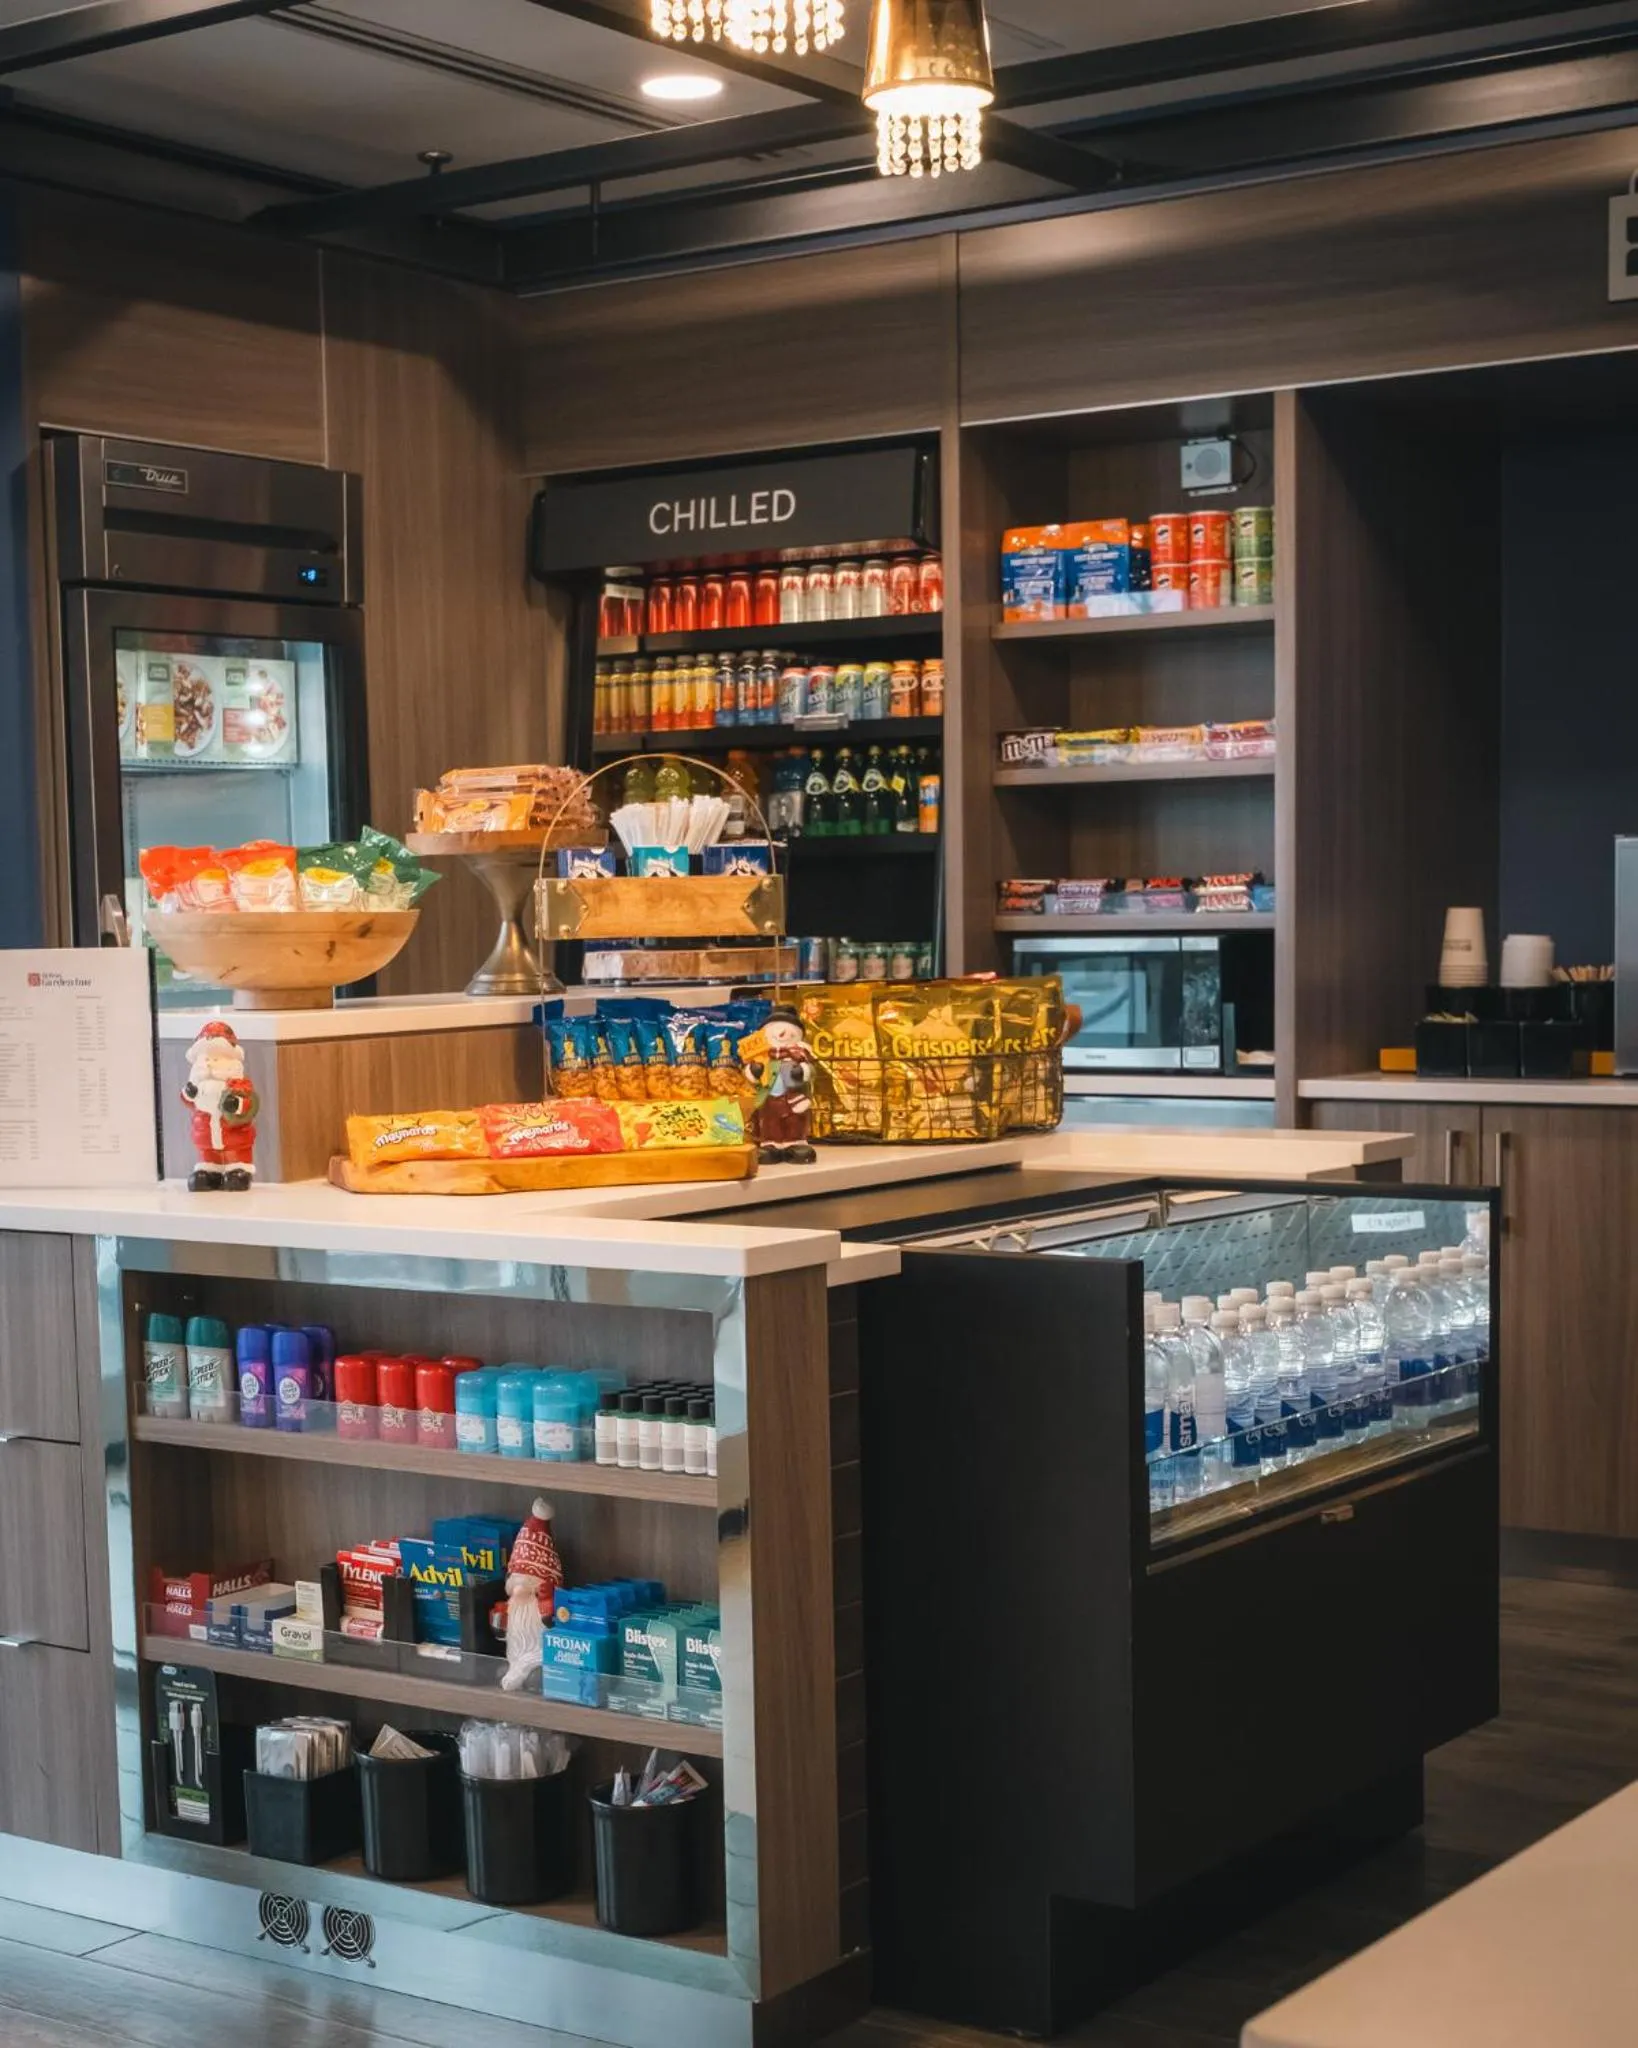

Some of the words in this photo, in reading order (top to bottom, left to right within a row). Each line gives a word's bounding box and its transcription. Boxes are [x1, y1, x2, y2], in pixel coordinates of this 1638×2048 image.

[649, 489, 796, 535] CHILLED
[375, 1125, 437, 1147] Maynards
[508, 1120, 570, 1144] Maynards
[213, 1575, 252, 1597] HALLS
[410, 1563, 465, 1588] Advil
[165, 1584, 192, 1599] HALLS
[166, 1601, 192, 1616] HALLS
[281, 1626, 312, 1641] Gravol
[544, 1634, 591, 1655] TROJAN
[625, 1627, 668, 1650] Blistex
[685, 1637, 721, 1658] Bliste
